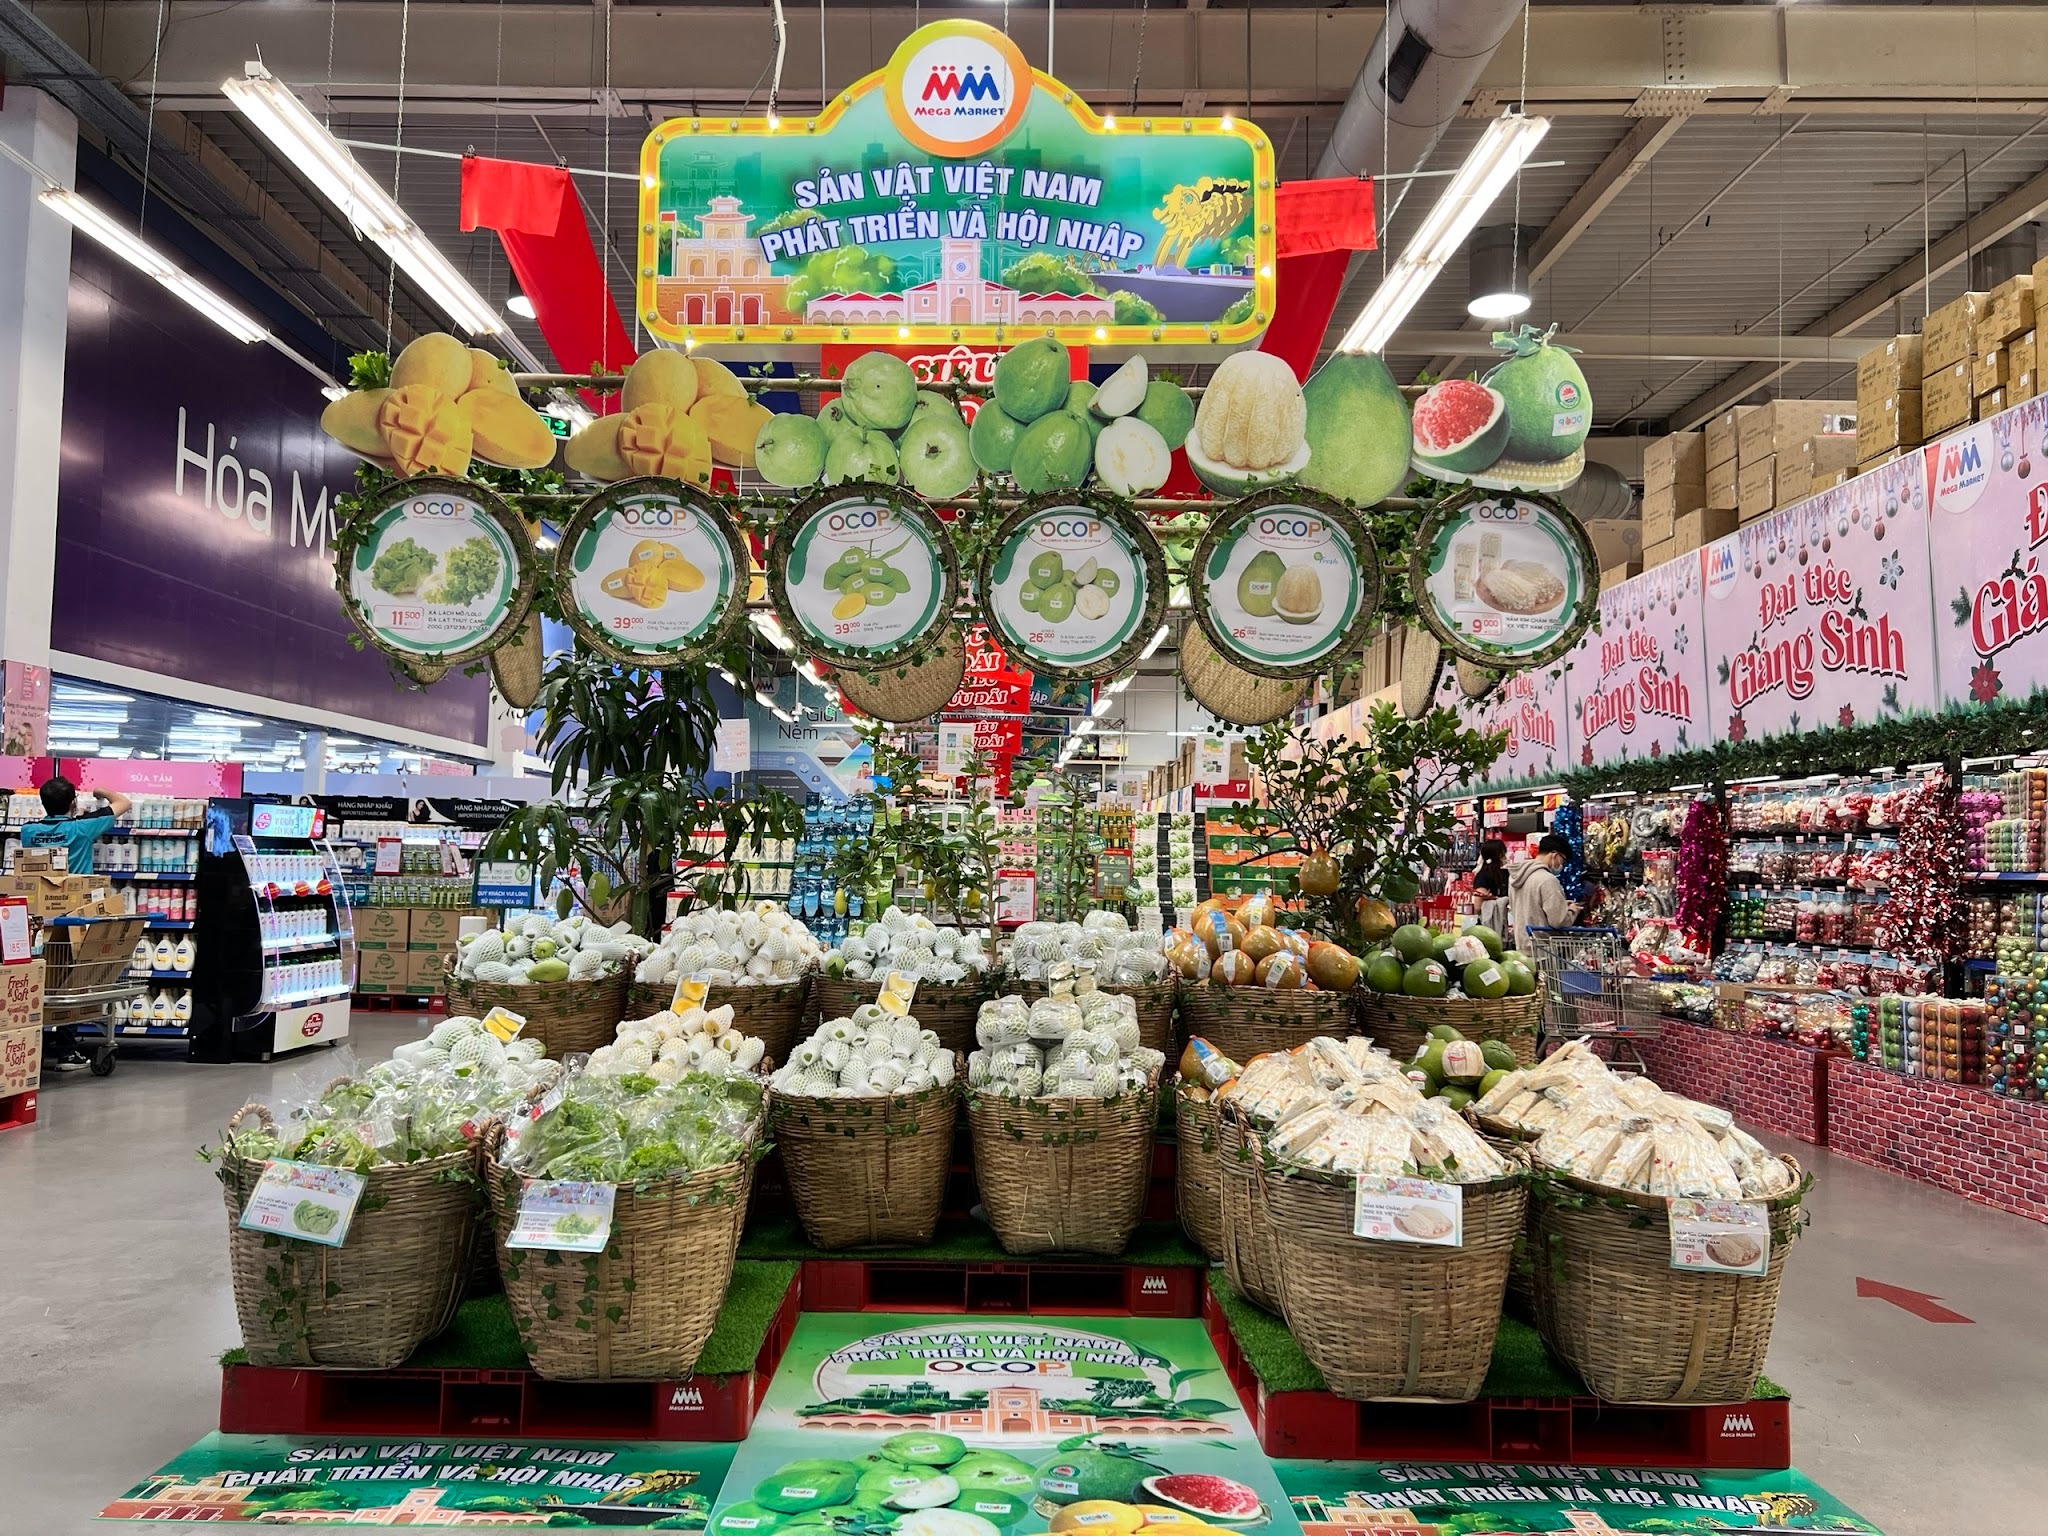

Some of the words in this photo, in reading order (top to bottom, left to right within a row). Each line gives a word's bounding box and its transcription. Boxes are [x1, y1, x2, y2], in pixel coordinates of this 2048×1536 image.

[914, 107, 951, 116] Mega
[954, 107, 1005, 116] Market
[793, 166, 865, 208] SẢN
[872, 162, 934, 201] VẬT
[943, 161, 1015, 201] VIỆT
[1022, 168, 1102, 207] NAM
[760, 218, 843, 263] PHÁT
[848, 200, 940, 243] TRIỂN
[945, 211, 987, 239] VÀ
[996, 208, 1050, 248] HỘI
[1056, 218, 1143, 260] NHẬP
[176, 406, 272, 537] Hóa
[1939, 485, 1959, 497] Mega
[1958, 472, 1985, 490] Market
[413, 501, 465, 516] OCOP
[624, 509, 687, 525] OCOP
[829, 510, 890, 531] OCOP
[1040, 521, 1101, 537] OCOP
[1260, 518, 1321, 537] OCOP
[1760, 574, 1798, 633] Đại
[1803, 559, 1853, 609] tiệc
[1601, 635, 1625, 680] Đại
[1628, 626, 1658, 663] tiệc
[1729, 626, 1816, 710] Giáng
[1820, 609, 1908, 681] Sinh
[1582, 678, 1636, 740] Giáng
[1639, 666, 1692, 724] Sinh
[779, 724, 818, 743] Nệm
[975, 720, 998, 733] IÊU
[1521, 702, 1556, 751] Sinh
[1236, 783, 1246, 792] 17
[8, 974, 29, 990] Fresh
[5, 1038, 26, 1054] Fresh
[862, 1334, 922, 1349] SẢN
[928, 1333, 980, 1348] VẬT
[987, 1333, 1048, 1347] VIỆT
[1052, 1337, 1124, 1352] NAM
[830, 1349, 900, 1365] PHÁT
[909, 1344, 986, 1360] TRIỂN
[991, 1347, 1028, 1360] VÀ
[1033, 1348, 1081, 1364] HỘI
[1085, 1352, 1162, 1368] NHẬP
[927, 1360, 1066, 1374] OCOP
[286, 1442, 374, 1465] SẢN
[378, 1442, 447, 1465] VẬT
[453, 1442, 528, 1465] VIỆT
[529, 1447, 618, 1467] NAM
[221, 1463, 317, 1489] PHÁT
[330, 1459, 432, 1481] TRIỂN
[438, 1462, 480, 1480] VÀ
[494, 1465, 548, 1485] HỘI
[552, 1469, 645, 1495] NHẬP
[1377, 1463, 1453, 1484] SẢN
[1454, 1463, 1520, 1482] VẬT
[1522, 1462, 1599, 1483] VIỆT
[1616, 1468, 1700, 1489] NAM
[1361, 1488, 1448, 1510] PHÁT
[1448, 1482, 1541, 1503] TRIỂN
[1551, 1484, 1601, 1503] VÀ
[1673, 1492, 1773, 1515] NHẬP
